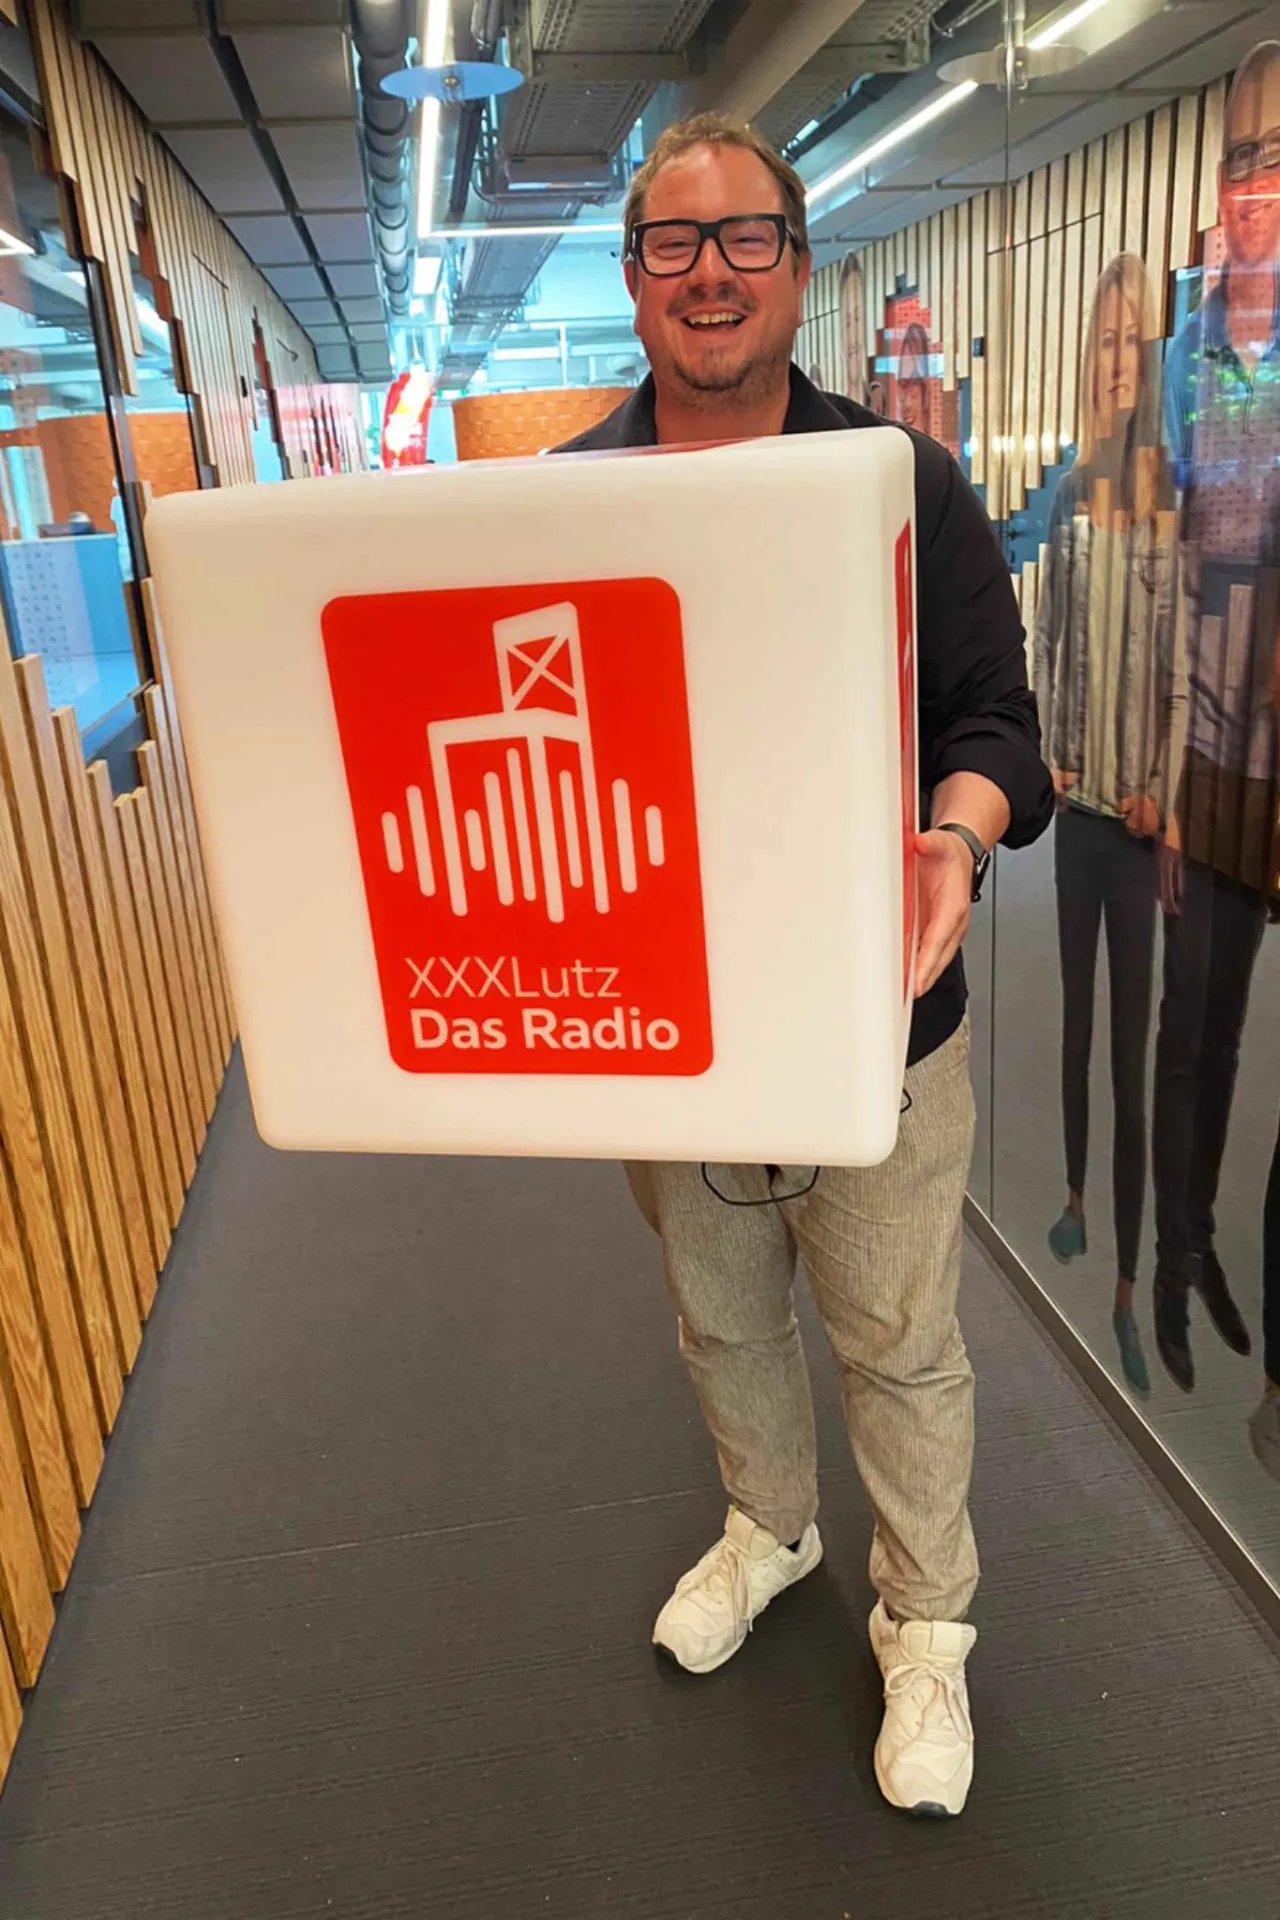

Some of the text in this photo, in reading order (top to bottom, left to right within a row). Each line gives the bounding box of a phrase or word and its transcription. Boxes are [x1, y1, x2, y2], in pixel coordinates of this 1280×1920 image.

[404, 956, 622, 998] XXXLutz
[410, 1006, 680, 1050] Das Radio
